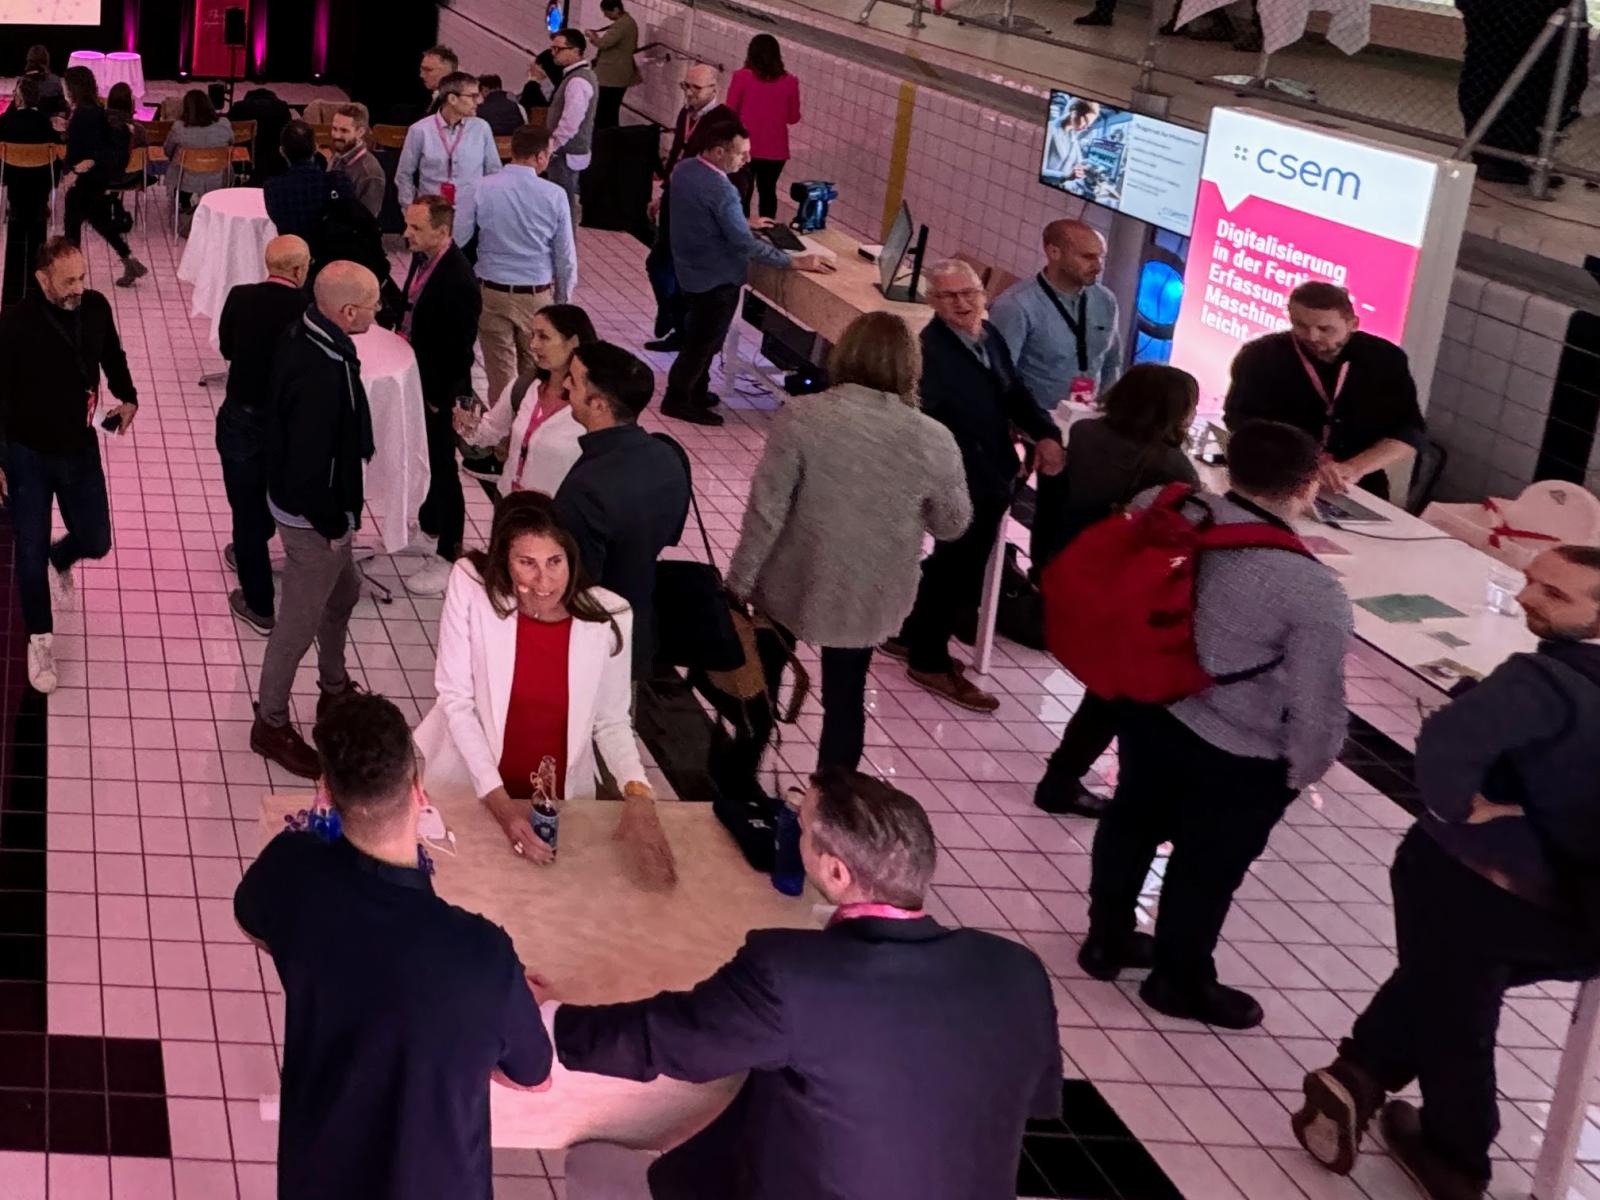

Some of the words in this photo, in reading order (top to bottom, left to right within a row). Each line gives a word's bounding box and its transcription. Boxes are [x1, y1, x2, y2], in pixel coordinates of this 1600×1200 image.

[1256, 148, 1361, 200] csem
[1212, 241, 1229, 262] in
[1233, 249, 1262, 275] der
[1216, 218, 1347, 287] Digitalisierung
[1200, 304, 1249, 341] leicht
